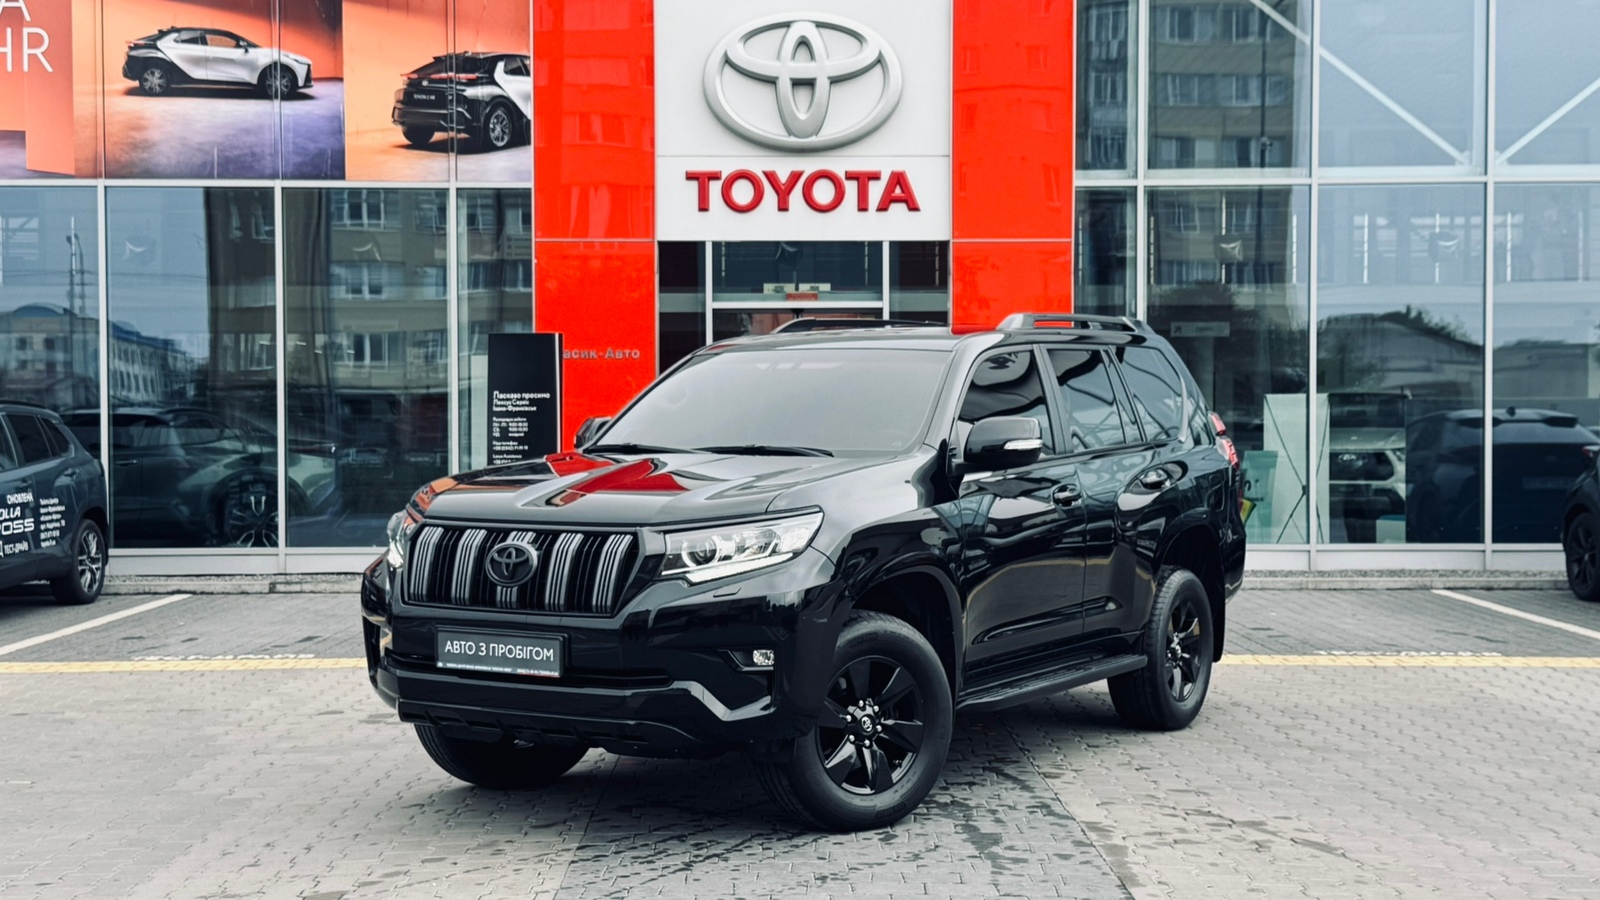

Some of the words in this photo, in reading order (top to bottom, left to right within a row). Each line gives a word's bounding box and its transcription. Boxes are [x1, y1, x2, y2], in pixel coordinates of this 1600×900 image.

[685, 168, 921, 213] TOYOTA
[0, 518, 35, 536] OSS
[445, 640, 476, 655] АВТО
[489, 643, 554, 662] ПРОБІГОМ
